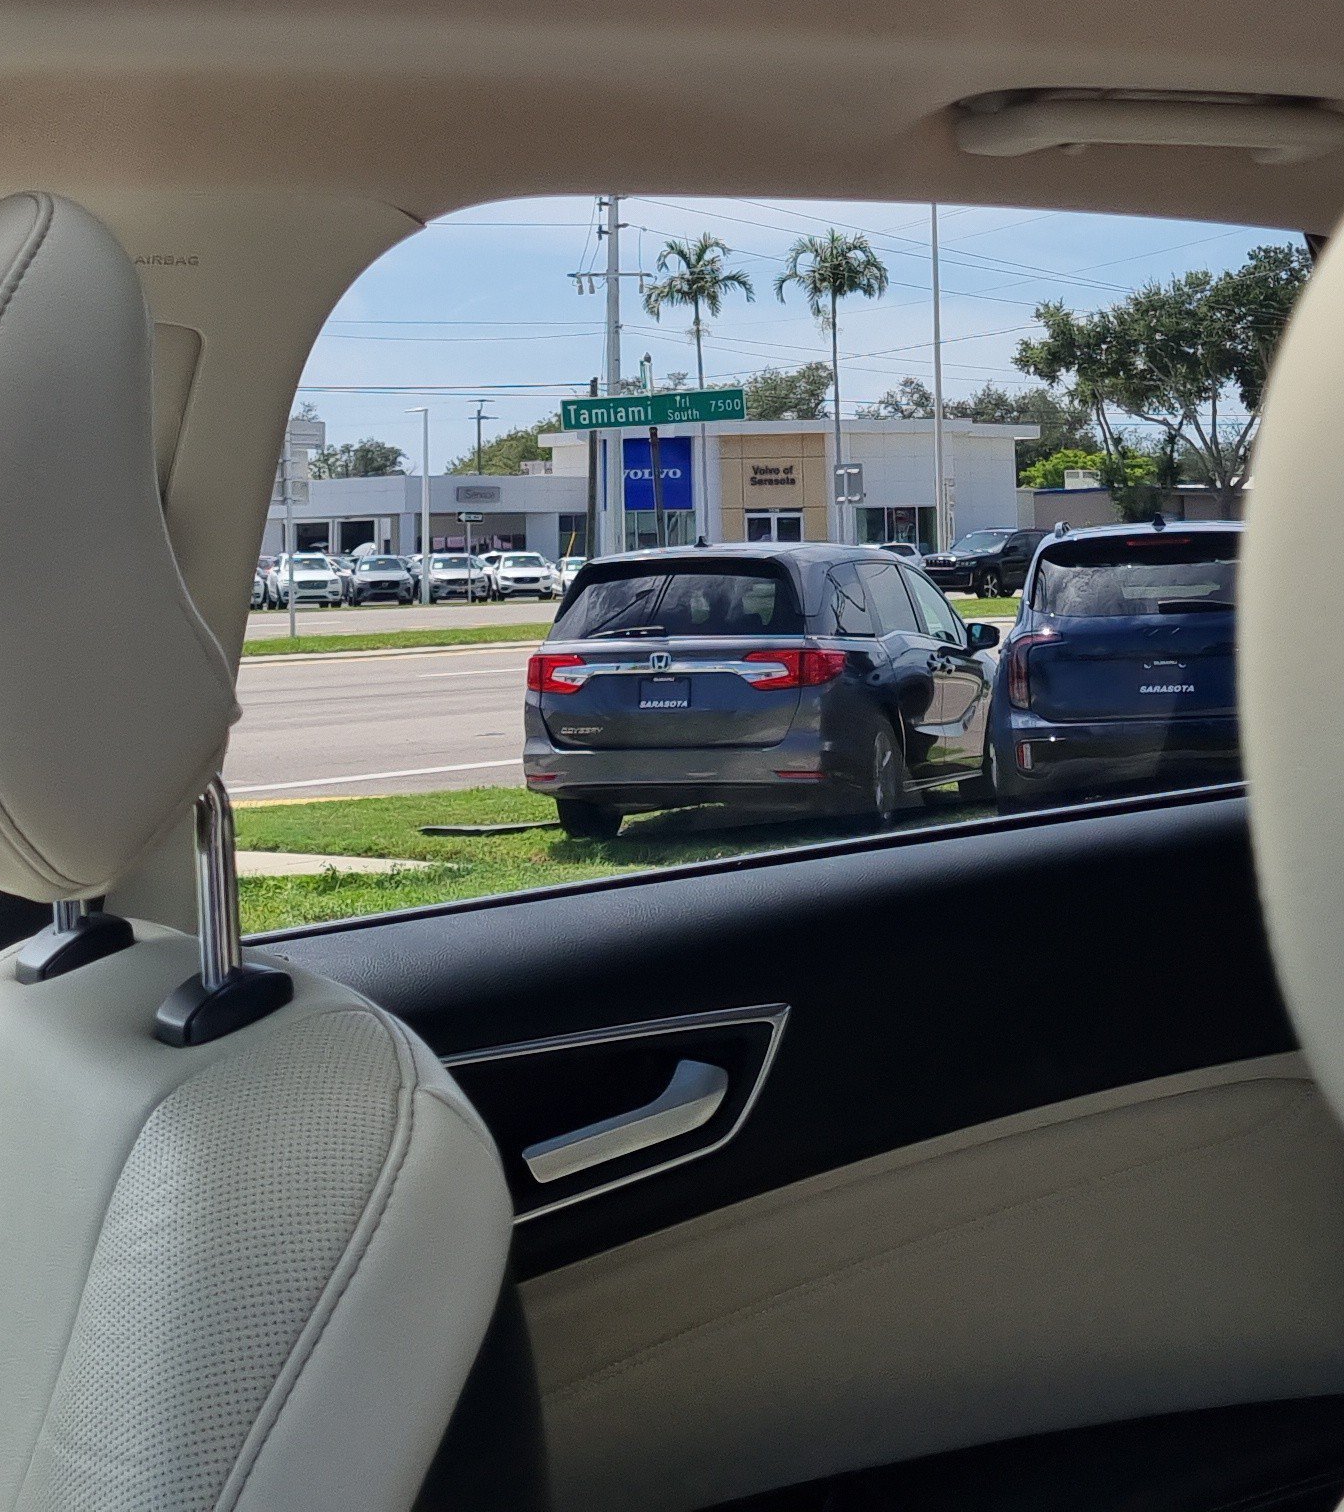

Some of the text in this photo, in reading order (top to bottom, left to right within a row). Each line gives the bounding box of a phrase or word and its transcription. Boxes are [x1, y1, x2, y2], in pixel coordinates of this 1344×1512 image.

[134, 254, 200, 266] AIRBAG
[674, 395, 690, 408] Trl
[709, 398, 742, 412] 7500
[566, 401, 653, 426] Tamiami
[667, 408, 700, 421] South
[752, 465, 794, 475] Volvo of
[750, 476, 796, 486] Sarasota
[1139, 684, 1195, 694] SARASOTA
[639, 700, 688, 709] SARASOTA
[560, 726, 604, 735] ODYSSEY
